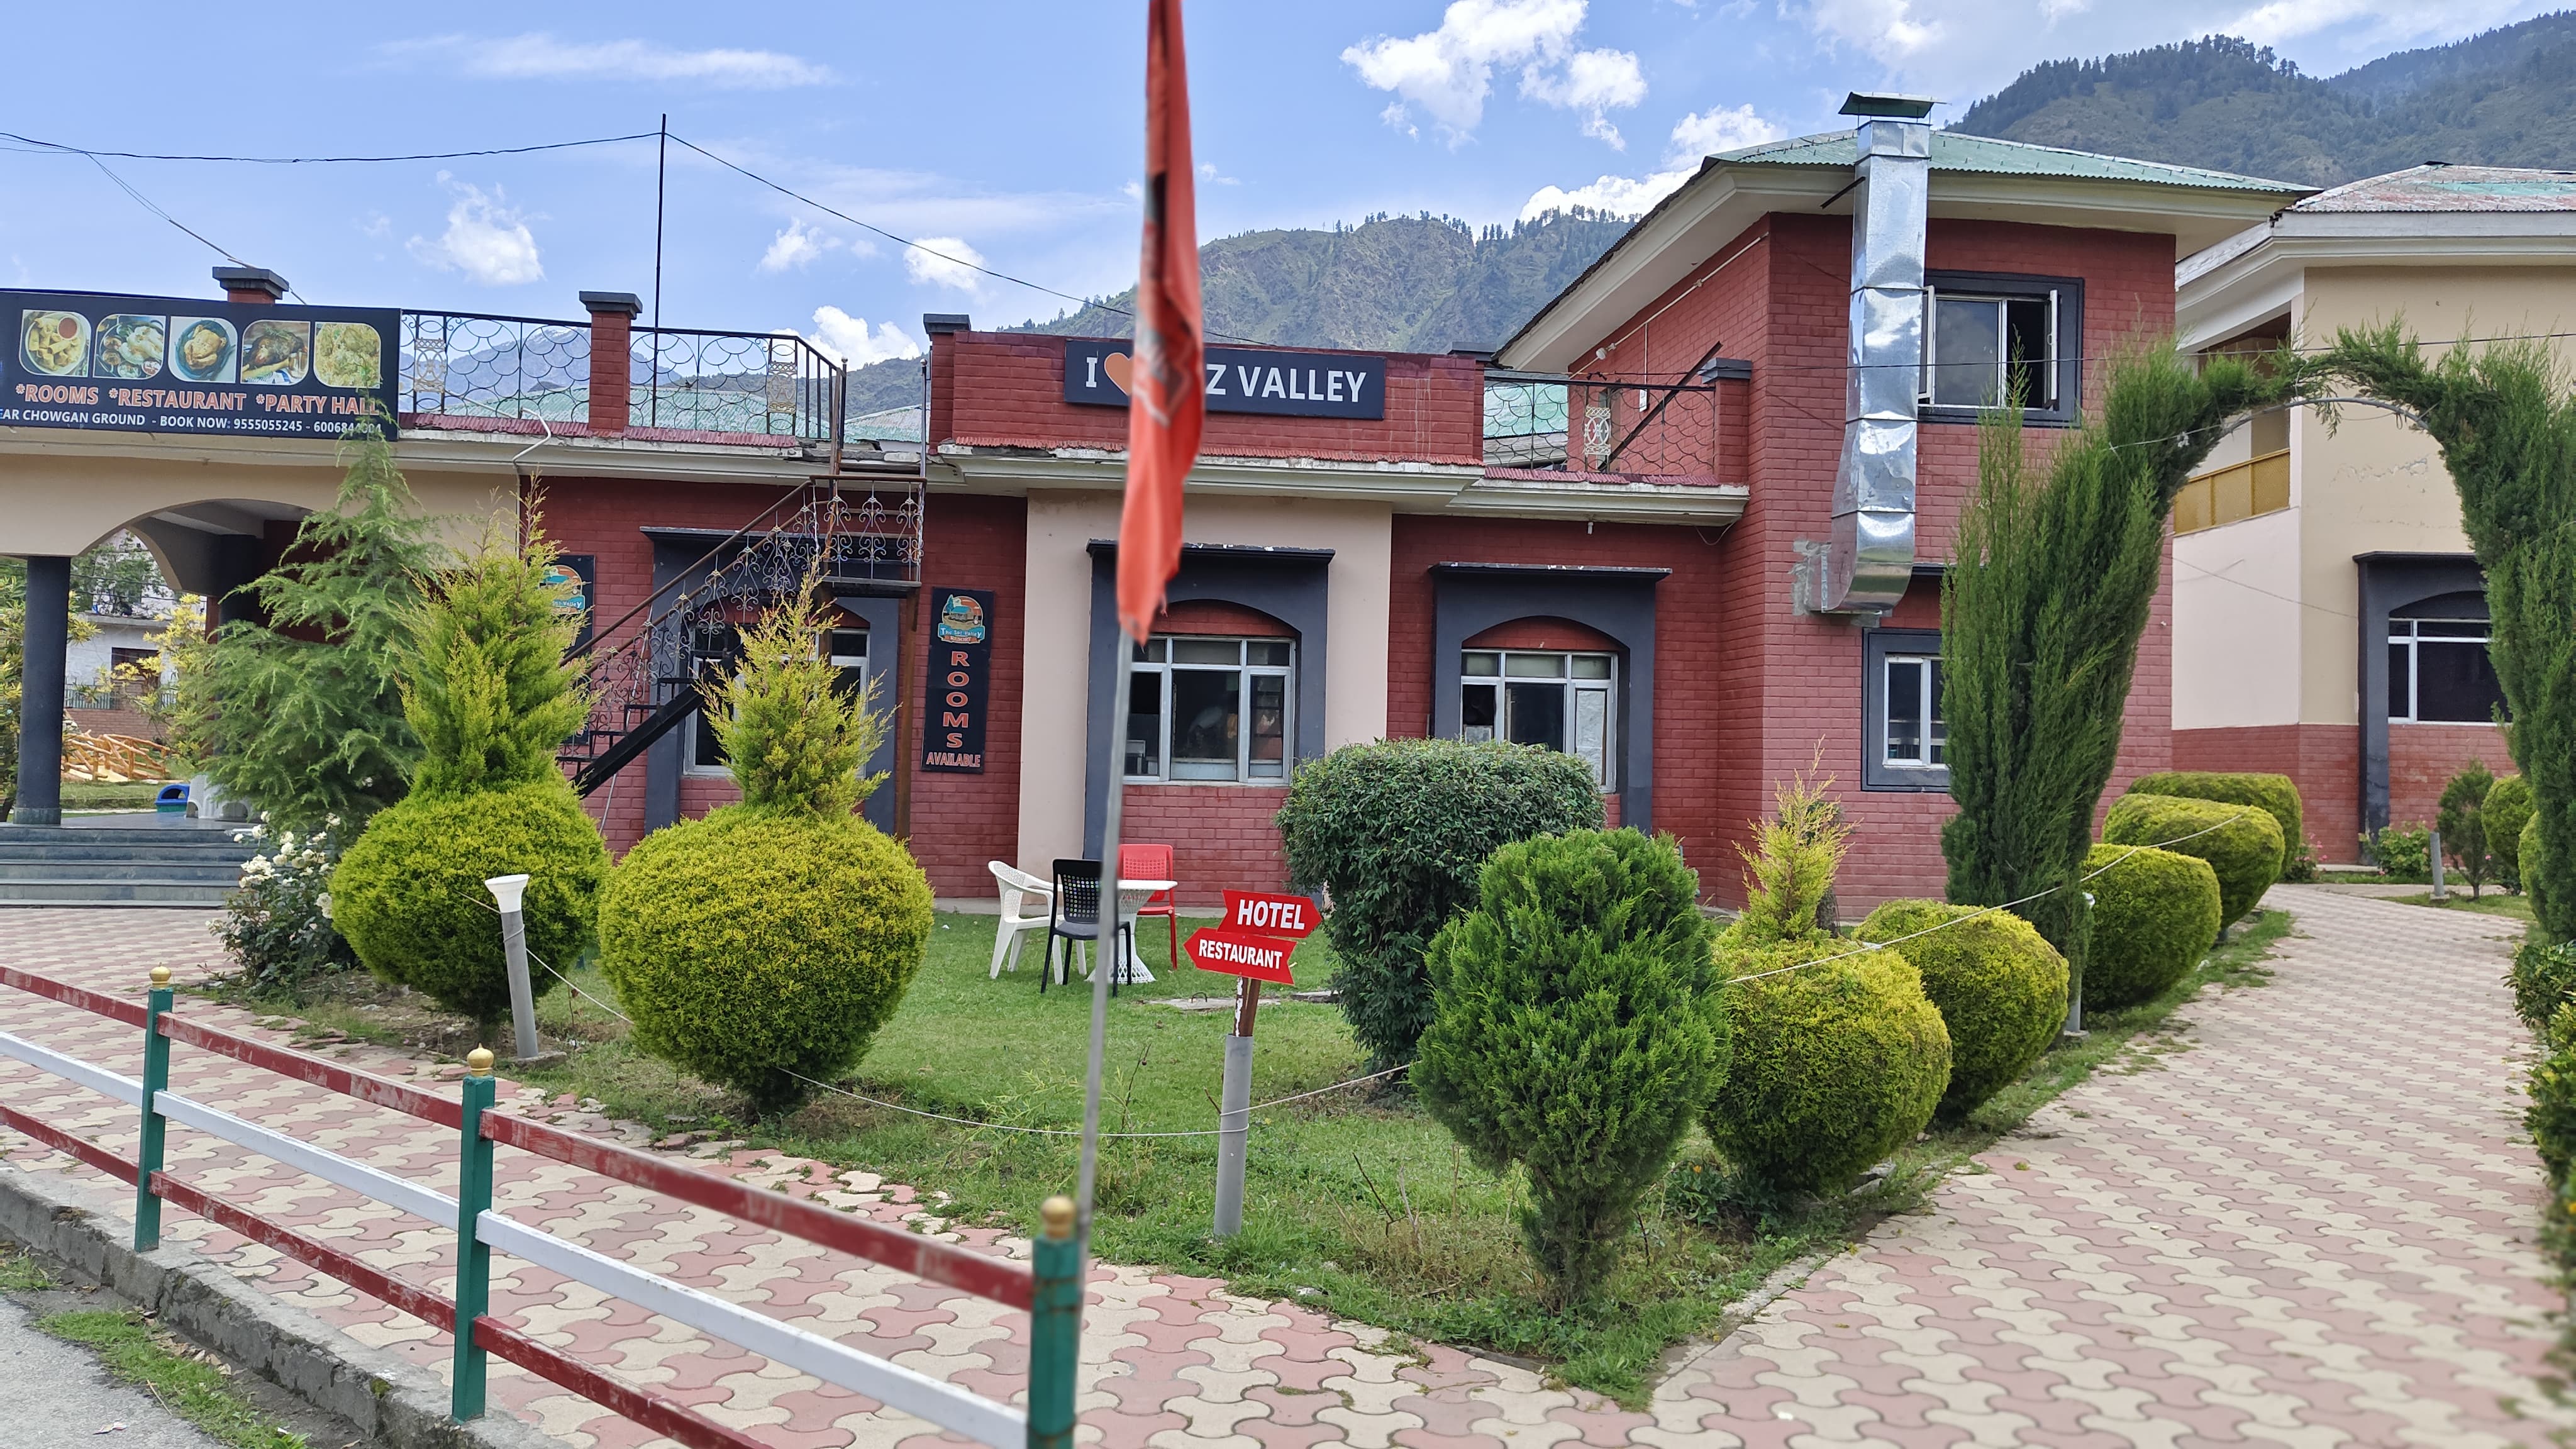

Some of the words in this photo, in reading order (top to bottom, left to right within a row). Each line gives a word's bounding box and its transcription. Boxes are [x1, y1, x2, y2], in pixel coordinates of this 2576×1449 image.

[1085, 357, 1097, 387] I
[1237, 365, 1367, 403] VALLEY
[23, 409, 89, 423] CHOWGAN
[92, 413, 145, 426] GROUND
[160, 416, 194, 428] BOOK
[197, 417, 231, 429] NOW:
[233, 418, 303, 431] 9555055245
[331, 397, 379, 416] HALL
[943, 651, 970, 748] ROOMS
[926, 752, 980, 767] AVAILABLE
[1237, 899, 1305, 930] HOTEL
[1199, 939, 1283, 969] RESTAURANT
